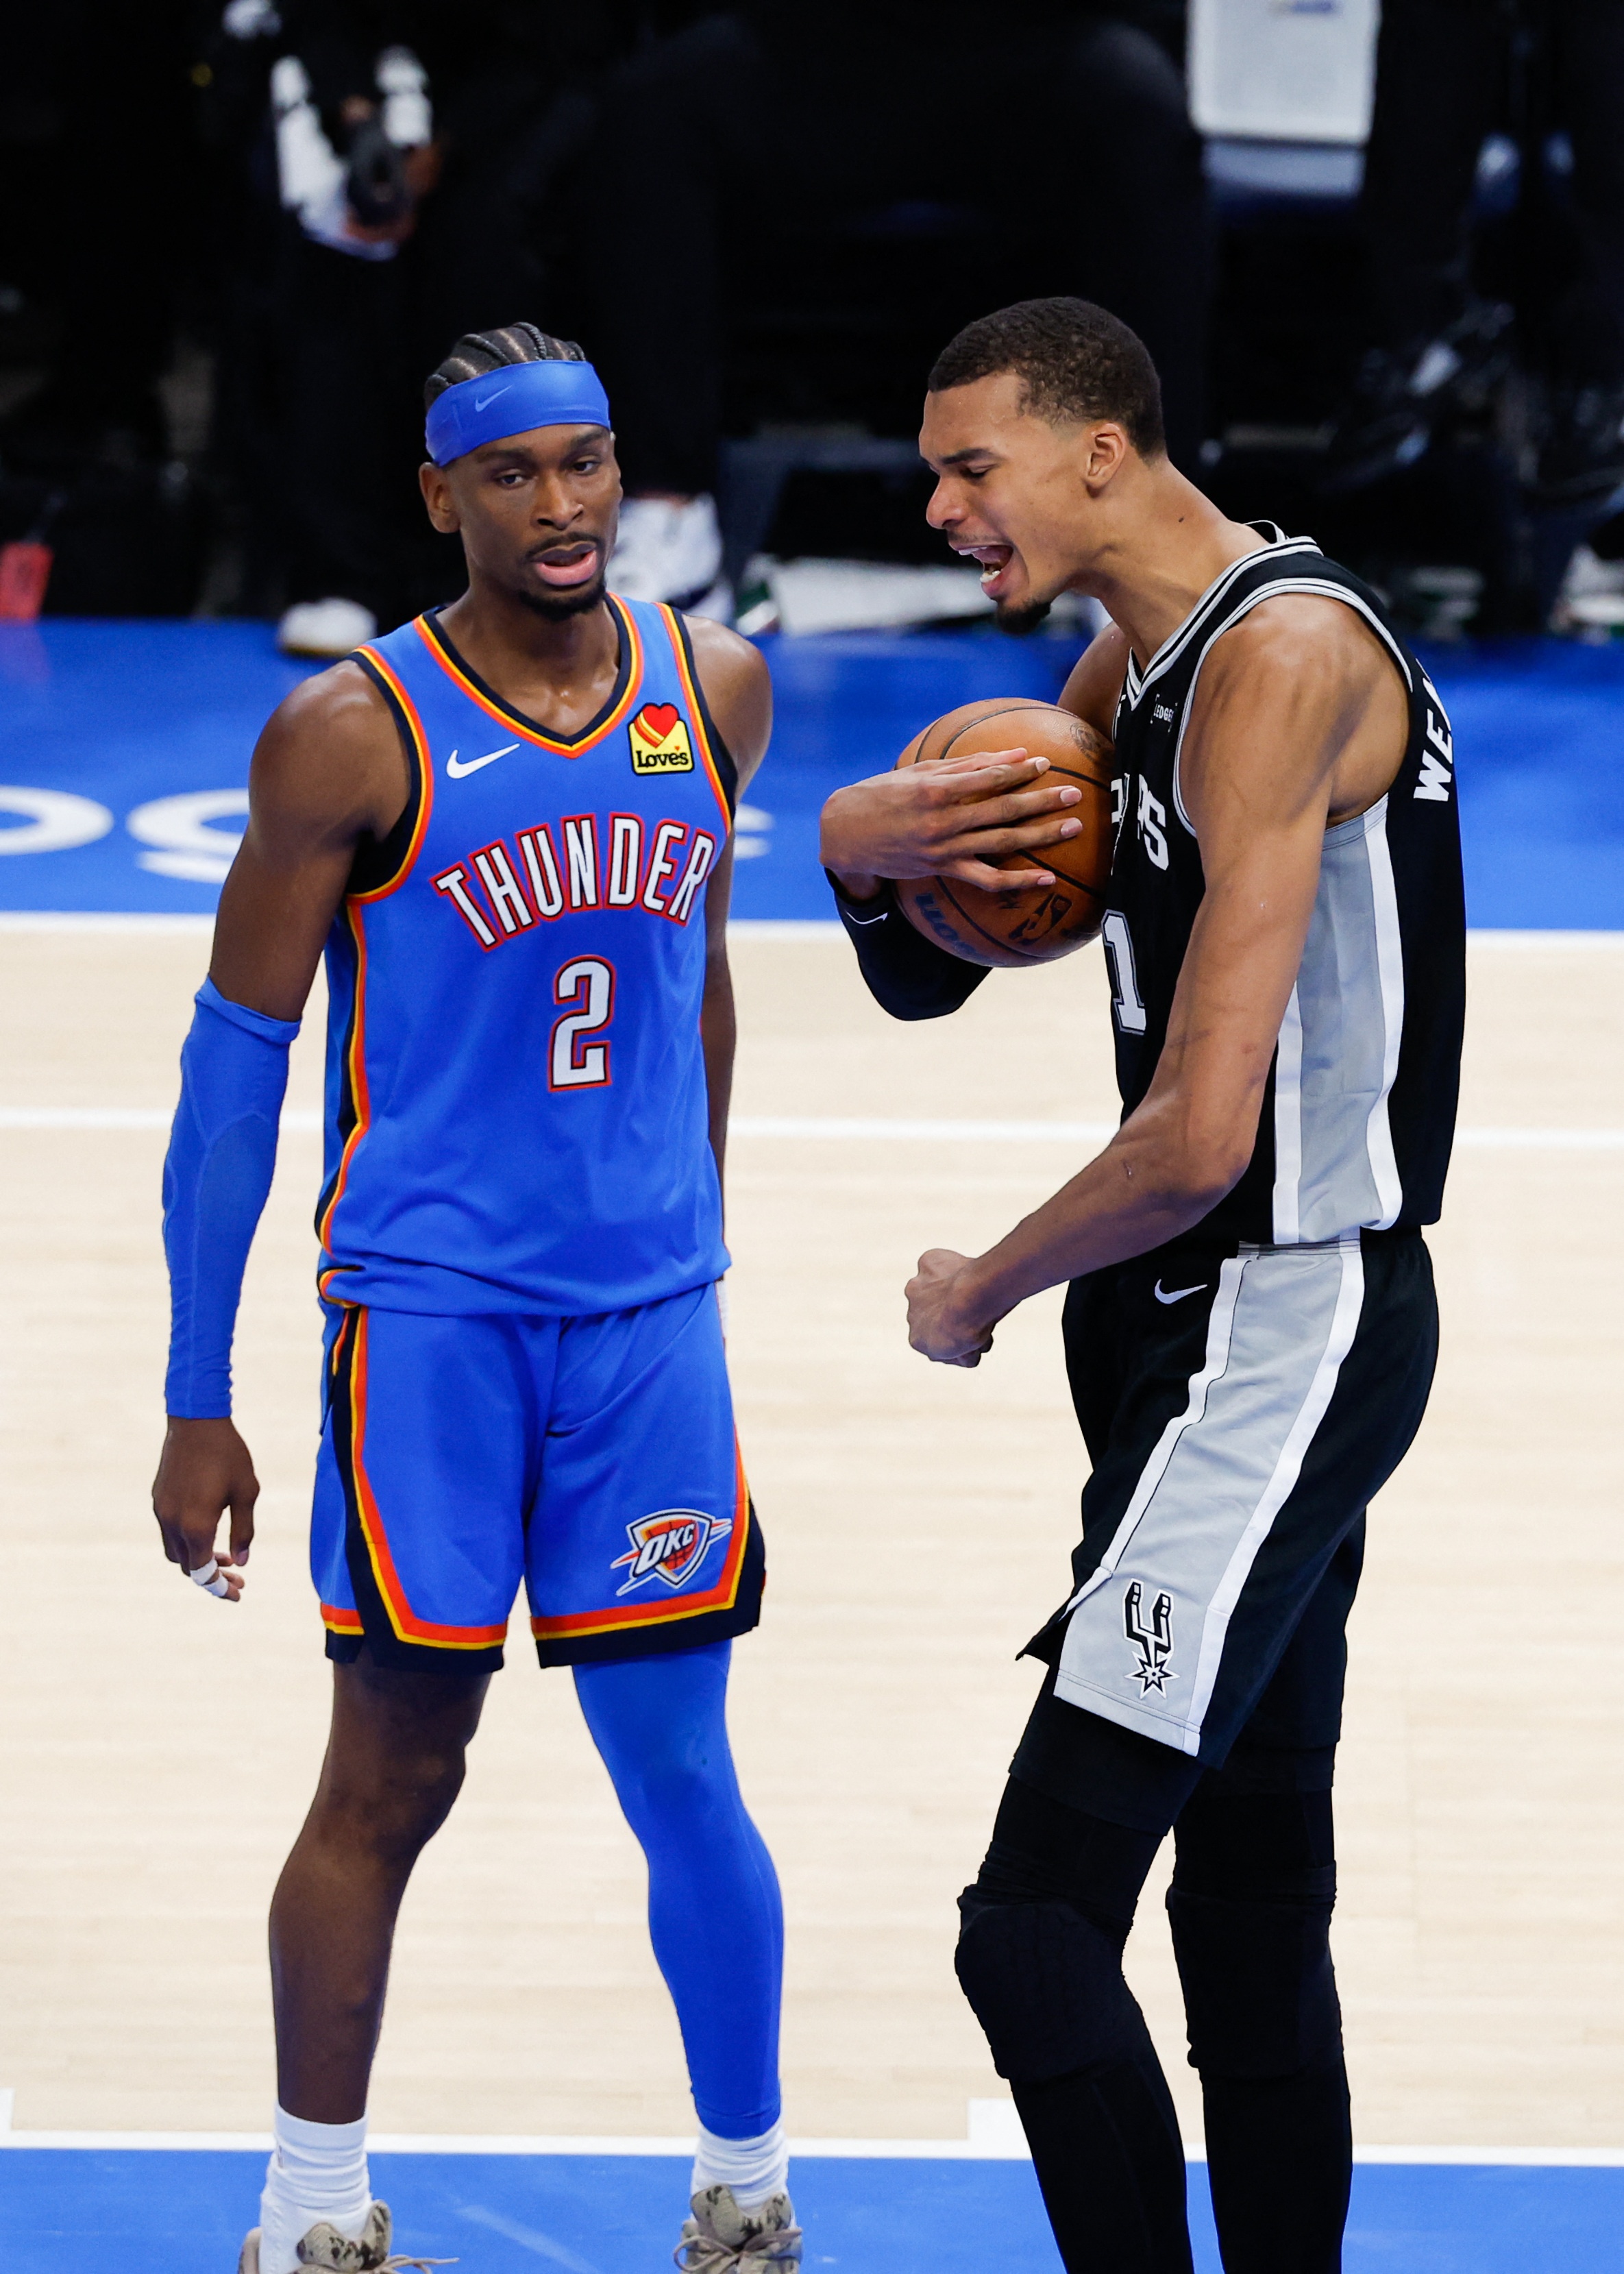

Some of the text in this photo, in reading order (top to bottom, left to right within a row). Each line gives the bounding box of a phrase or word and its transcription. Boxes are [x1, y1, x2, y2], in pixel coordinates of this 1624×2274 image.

[430, 813, 715, 952] THUNDER
[548, 954, 613, 1092] 2
[1101, 909, 1146, 1035] 1
[634, 1522, 696, 1577] OKC
